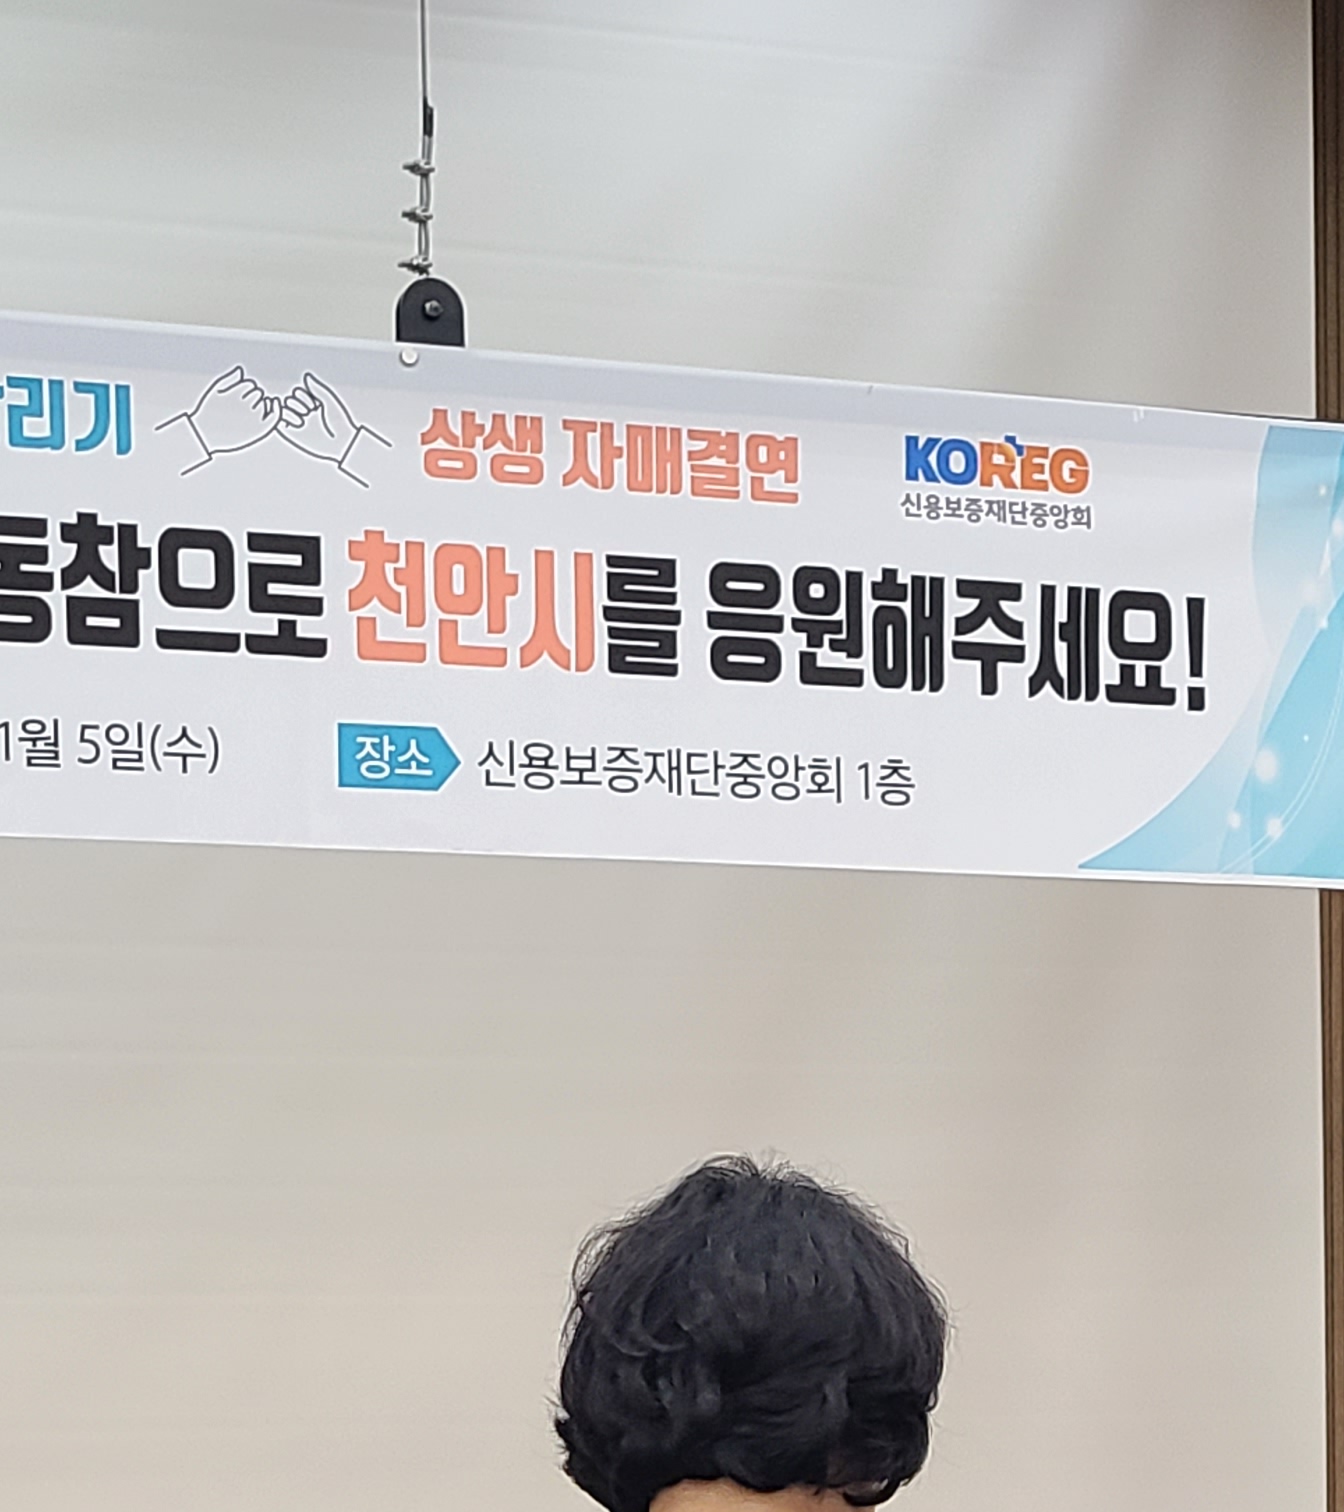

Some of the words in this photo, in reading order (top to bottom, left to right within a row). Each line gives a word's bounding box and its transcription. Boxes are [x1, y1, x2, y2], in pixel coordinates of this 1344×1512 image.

[420, 407, 545, 486] 상생
[561, 417, 799, 504] 자매결연
[903, 433, 1090, 495] KOREG
[900, 491, 1093, 530] 신용보증재단중앙회
[347, 528, 681, 679] 천안시를
[706, 561, 1207, 713] 응원해주세요!
[76, 722, 220, 774] 5일(수)
[355, 734, 435, 781] 장소
[477, 740, 843, 804] 신용보증재단중앙회
[858, 759, 916, 807] 1층
